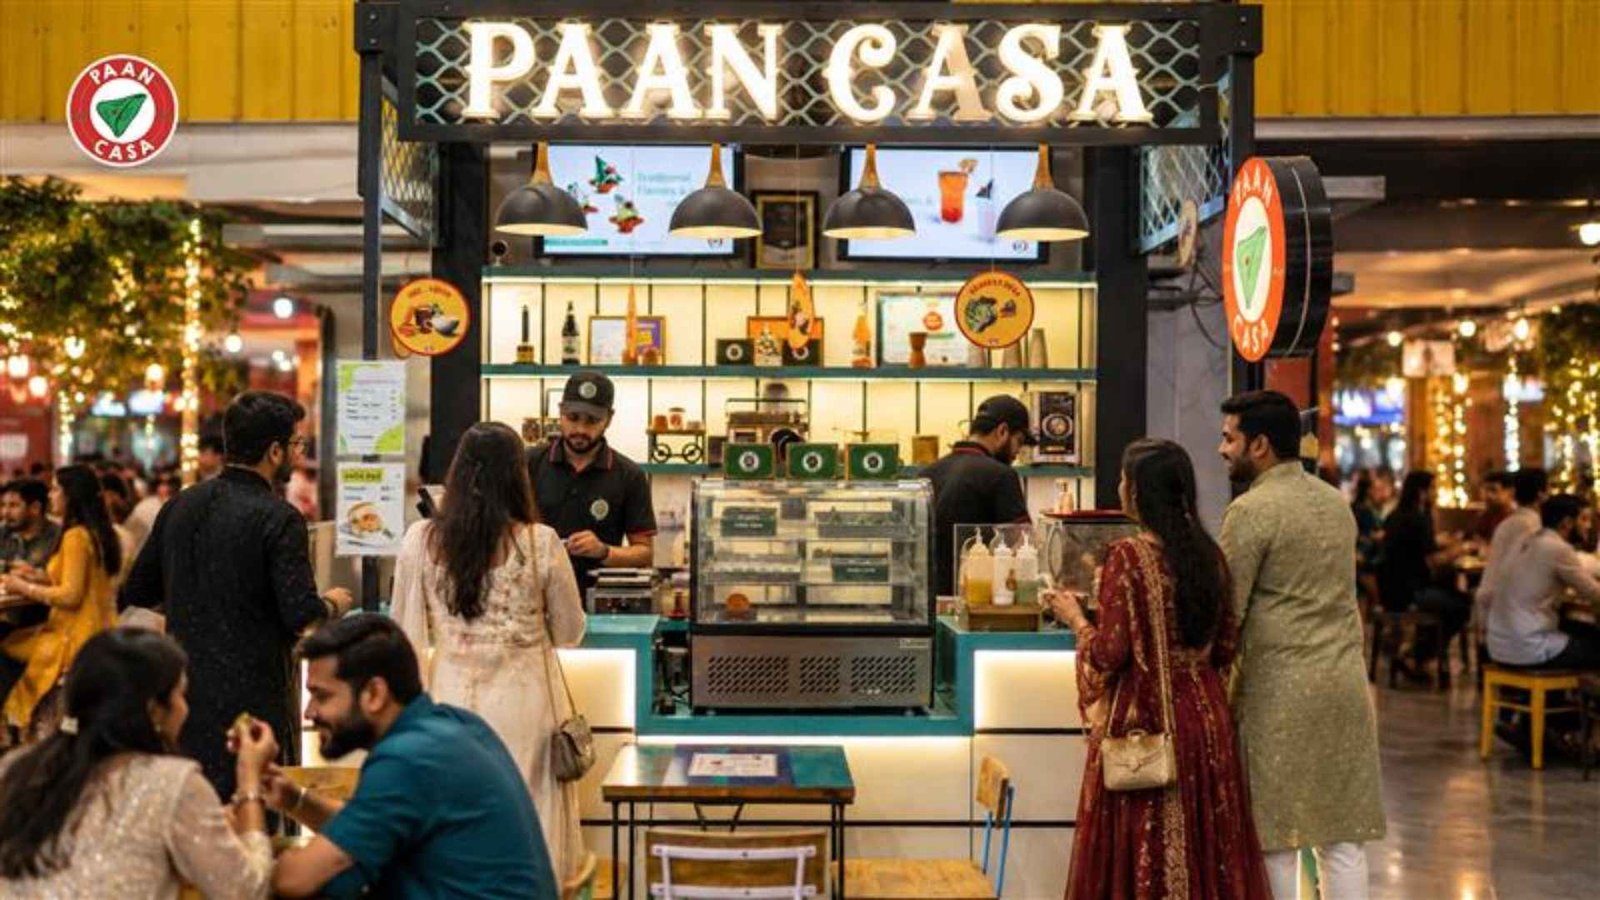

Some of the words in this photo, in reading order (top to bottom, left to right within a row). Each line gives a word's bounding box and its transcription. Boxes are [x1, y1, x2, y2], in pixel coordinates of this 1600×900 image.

[463, 21, 784, 121] PAAN
[824, 22, 1153, 123] CASA
[1234, 165, 1272, 208] PAAN
[1232, 313, 1270, 354] CASA
